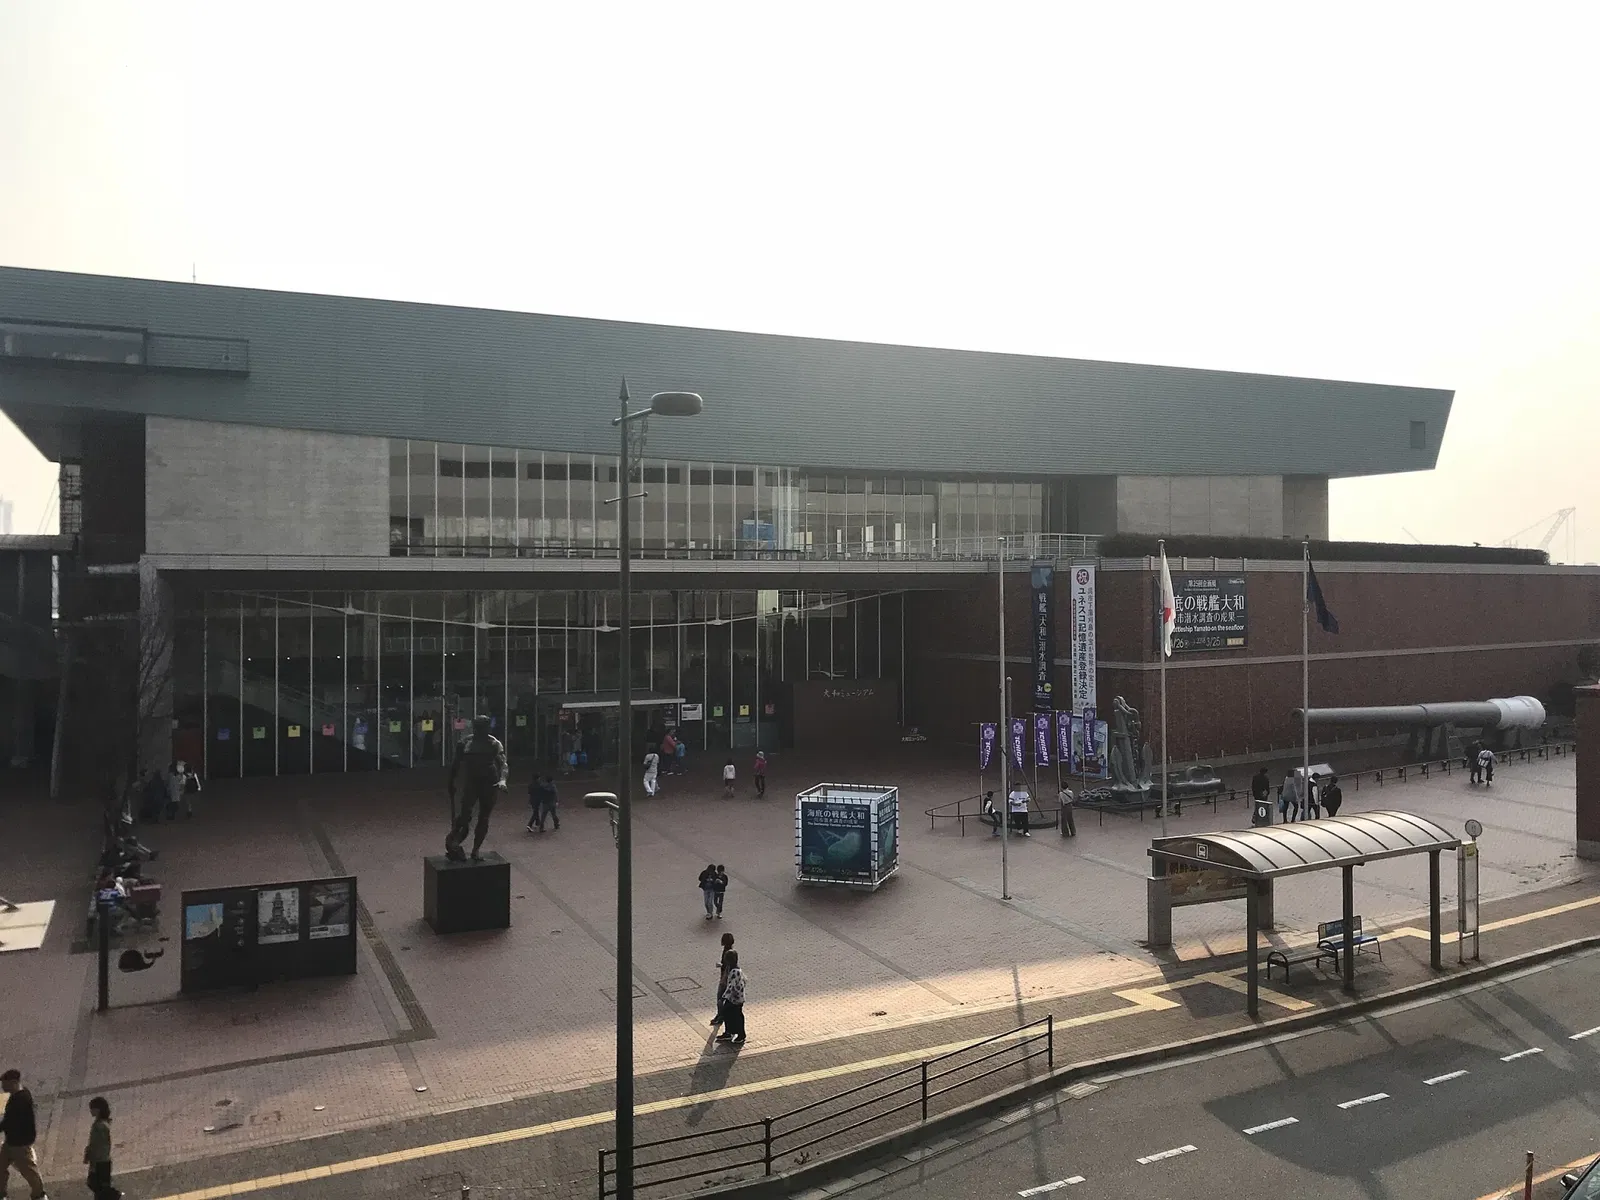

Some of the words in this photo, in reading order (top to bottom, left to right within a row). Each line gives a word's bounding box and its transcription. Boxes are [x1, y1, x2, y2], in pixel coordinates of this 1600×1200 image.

[1077, 570, 1089, 584] 祝
[1173, 594, 1245, 611] 底の戦艦大和
